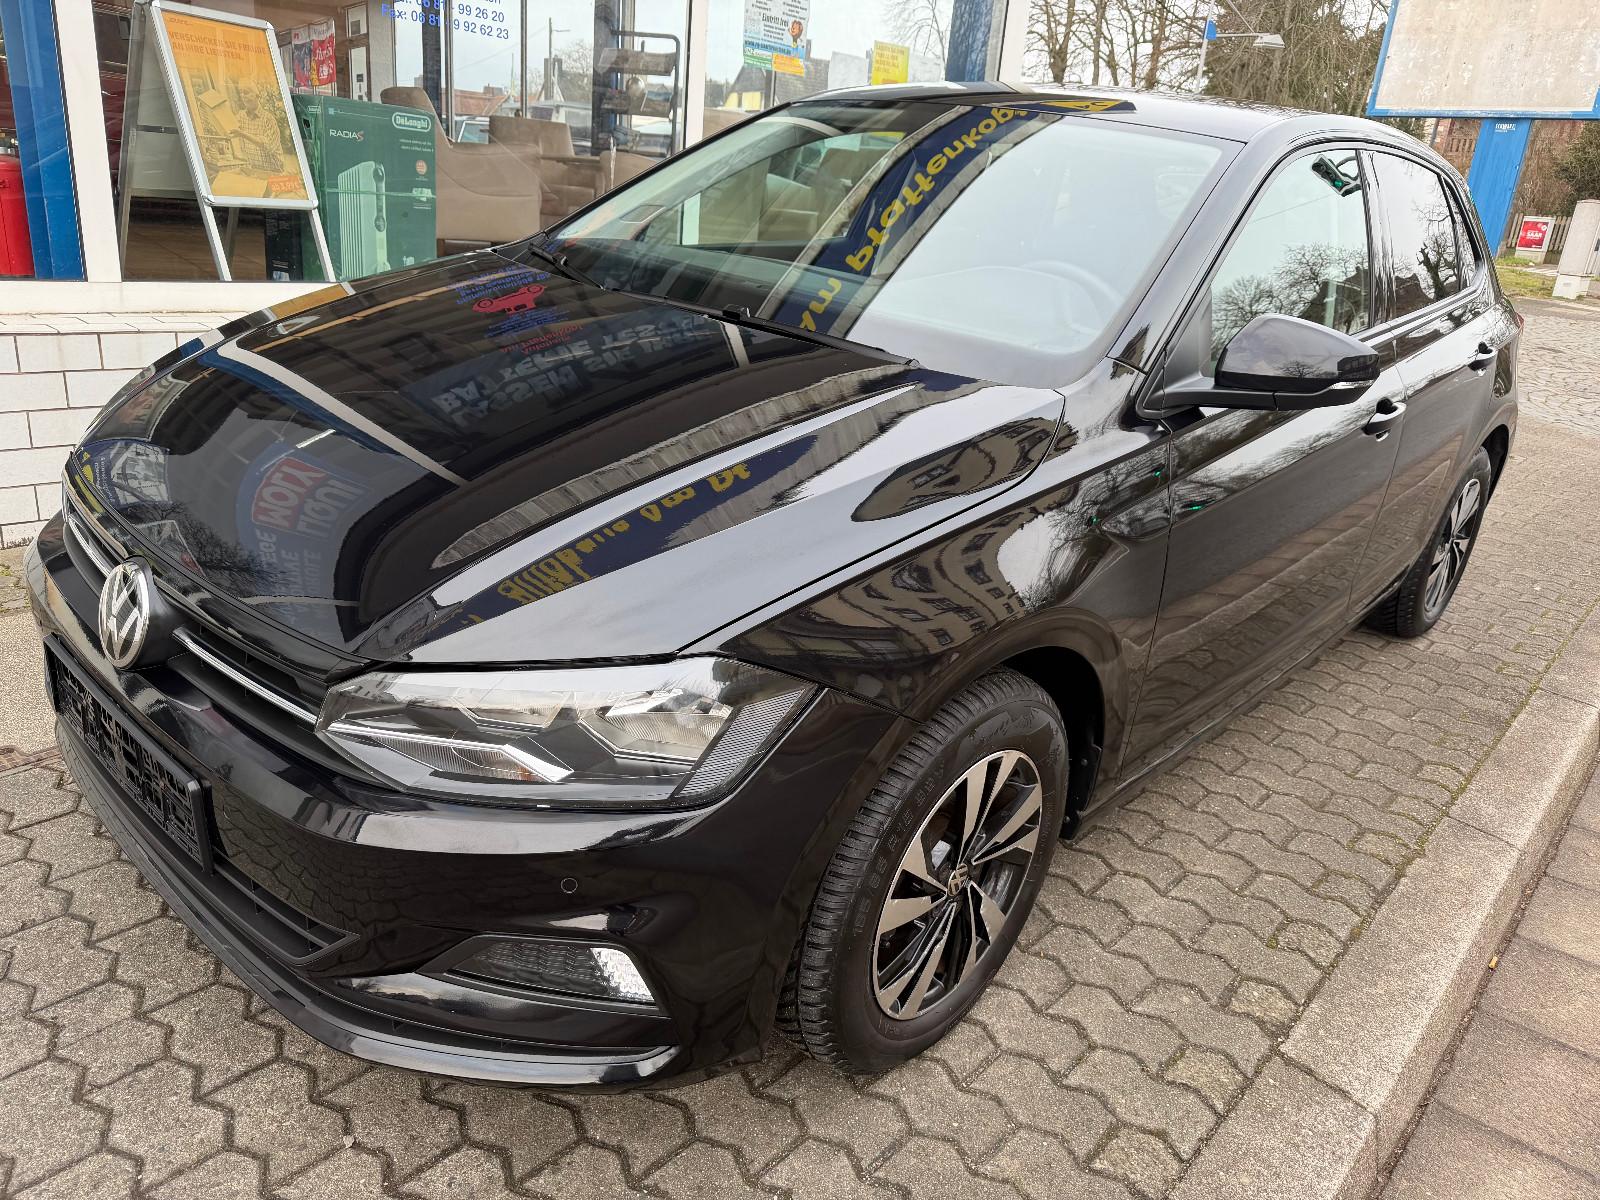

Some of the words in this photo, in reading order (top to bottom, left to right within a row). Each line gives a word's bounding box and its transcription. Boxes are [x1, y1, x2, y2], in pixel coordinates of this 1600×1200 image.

[381, 3, 407, 20] Fax:
[411, 10, 426, 24] 06
[463, 20, 477, 34] 92
[479, 24, 493, 37] 62
[496, 27, 509, 40] 23
[458, 3, 472, 16] 99
[475, 7, 488, 20] 26
[491, 12, 505, 23] 20
